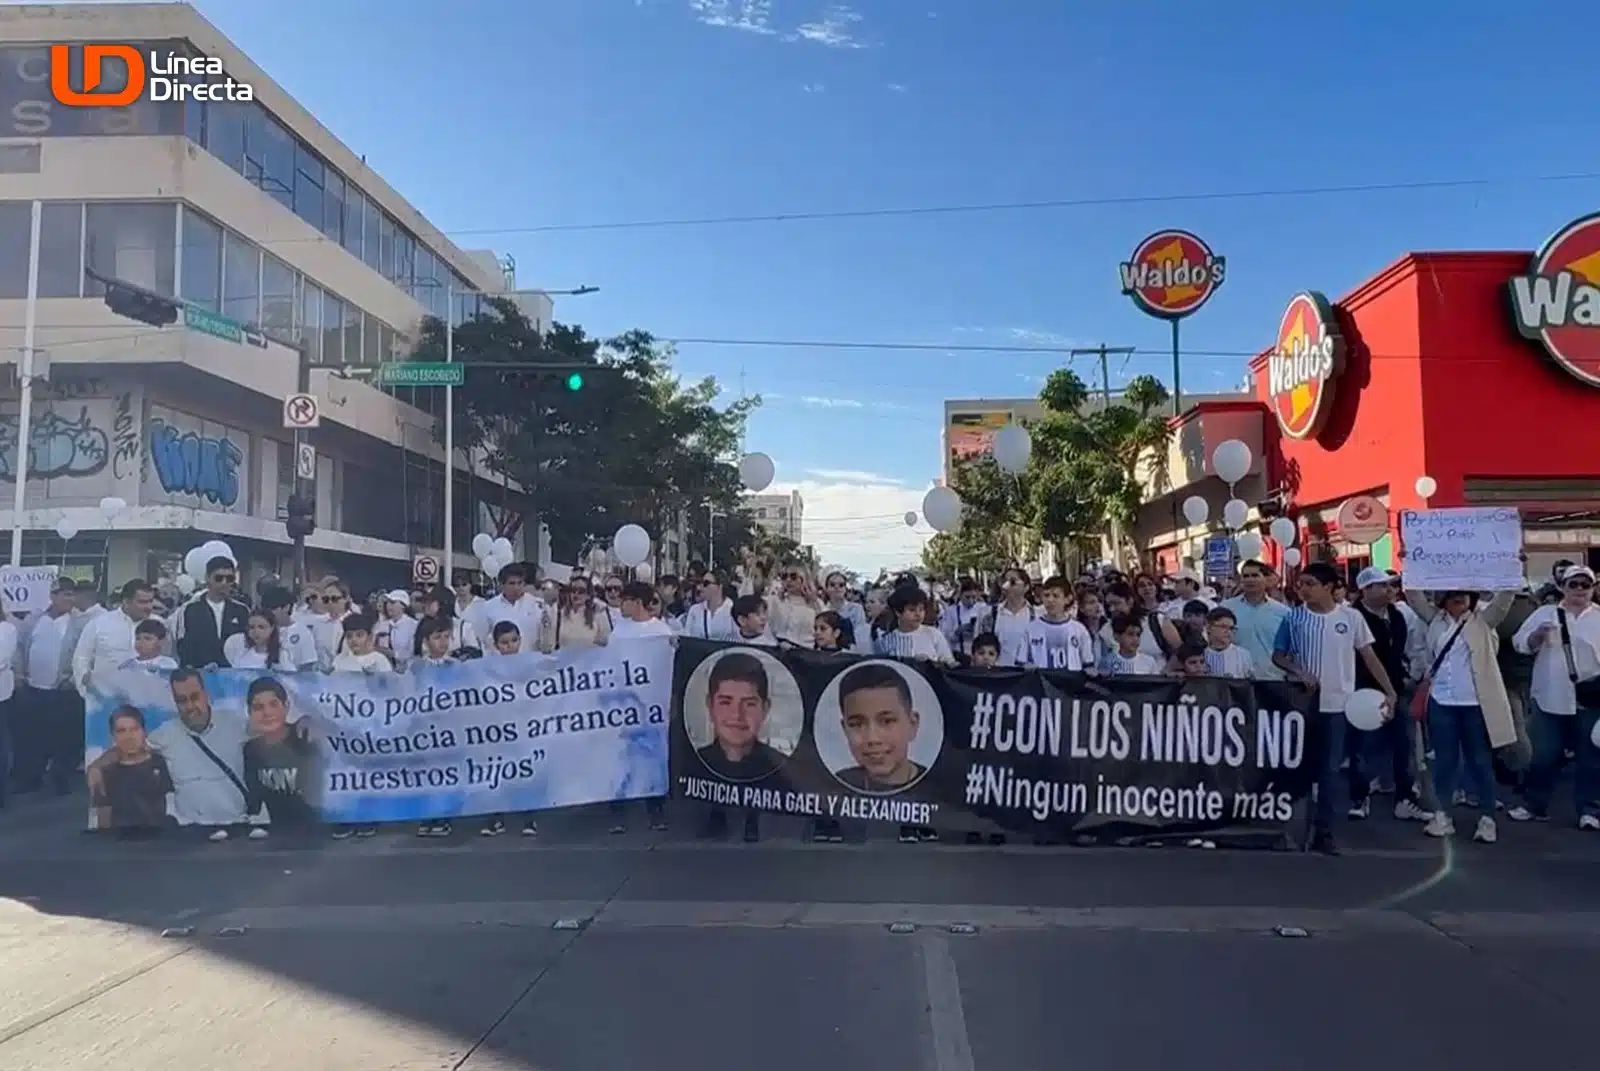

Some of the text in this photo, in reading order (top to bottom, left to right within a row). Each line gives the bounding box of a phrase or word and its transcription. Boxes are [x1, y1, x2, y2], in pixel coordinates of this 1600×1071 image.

[1121, 255, 1224, 290] Waldo's
[384, 368, 460, 381] MARIANO ESCOBEDO
[1268, 323, 1333, 397] Waldo's
[1049, 647, 1067, 668] 10
[384, 683, 516, 725] podemos
[525, 666, 615, 699] callar:
[622, 660, 650, 687] la
[327, 704, 664, 755] violencia nos arranca a
[970, 692, 1305, 769] #CON LOS NIÑOS NO
[330, 766, 459, 791] nuestros
[966, 763, 1293, 821] #Ningun inocente más
[743, 786, 782, 810] PARA
[785, 791, 823, 815] GAEL
[827, 795, 838, 816] Y
